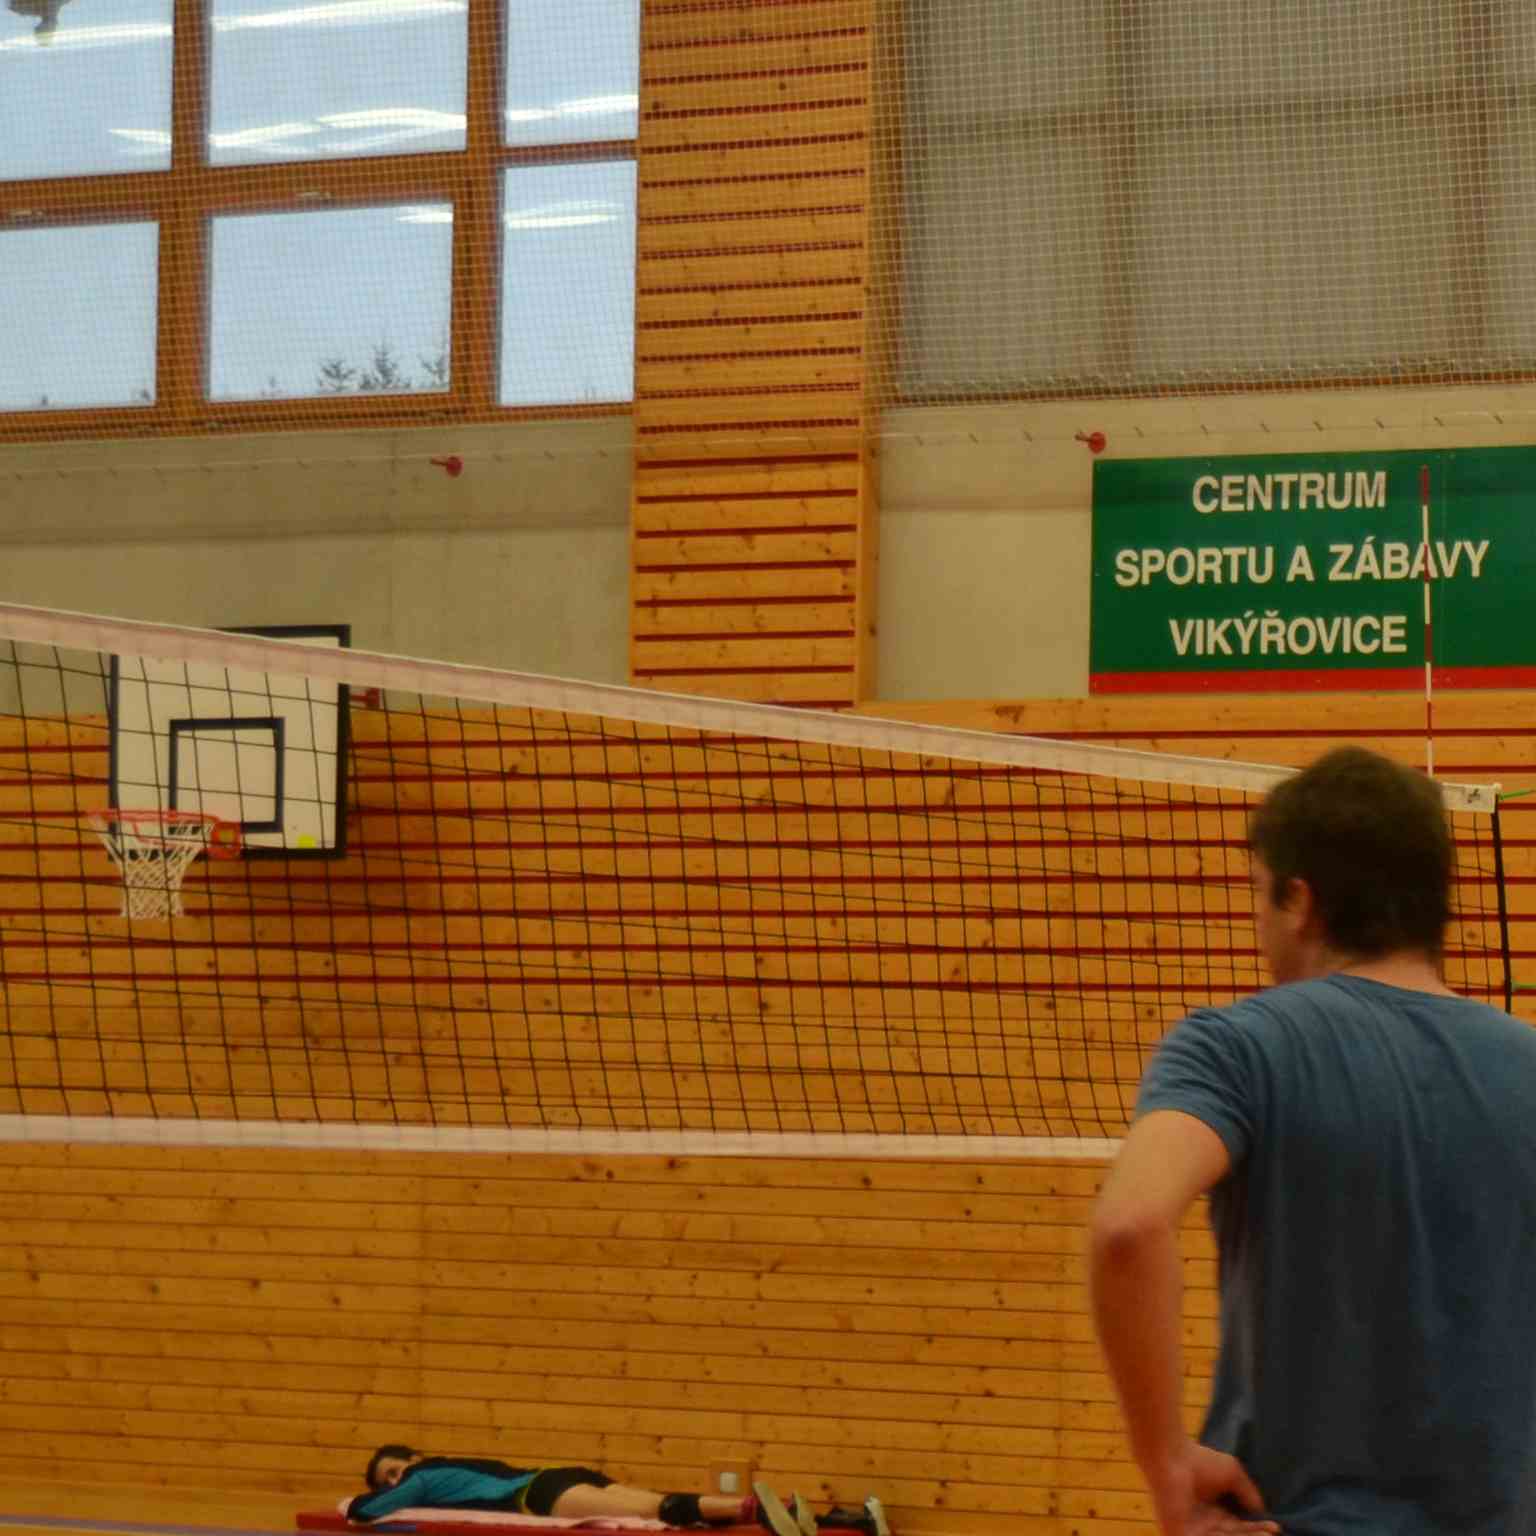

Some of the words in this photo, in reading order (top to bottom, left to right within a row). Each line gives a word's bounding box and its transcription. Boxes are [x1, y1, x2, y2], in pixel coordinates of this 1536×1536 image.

[1192, 470, 1387, 514] CENTRUM
[1114, 545, 1274, 587] SPORTU
[1286, 544, 1315, 582] A
[1327, 536, 1490, 582] ZÁBAVY
[1168, 608, 1408, 656] VIKÝŘOVICE
